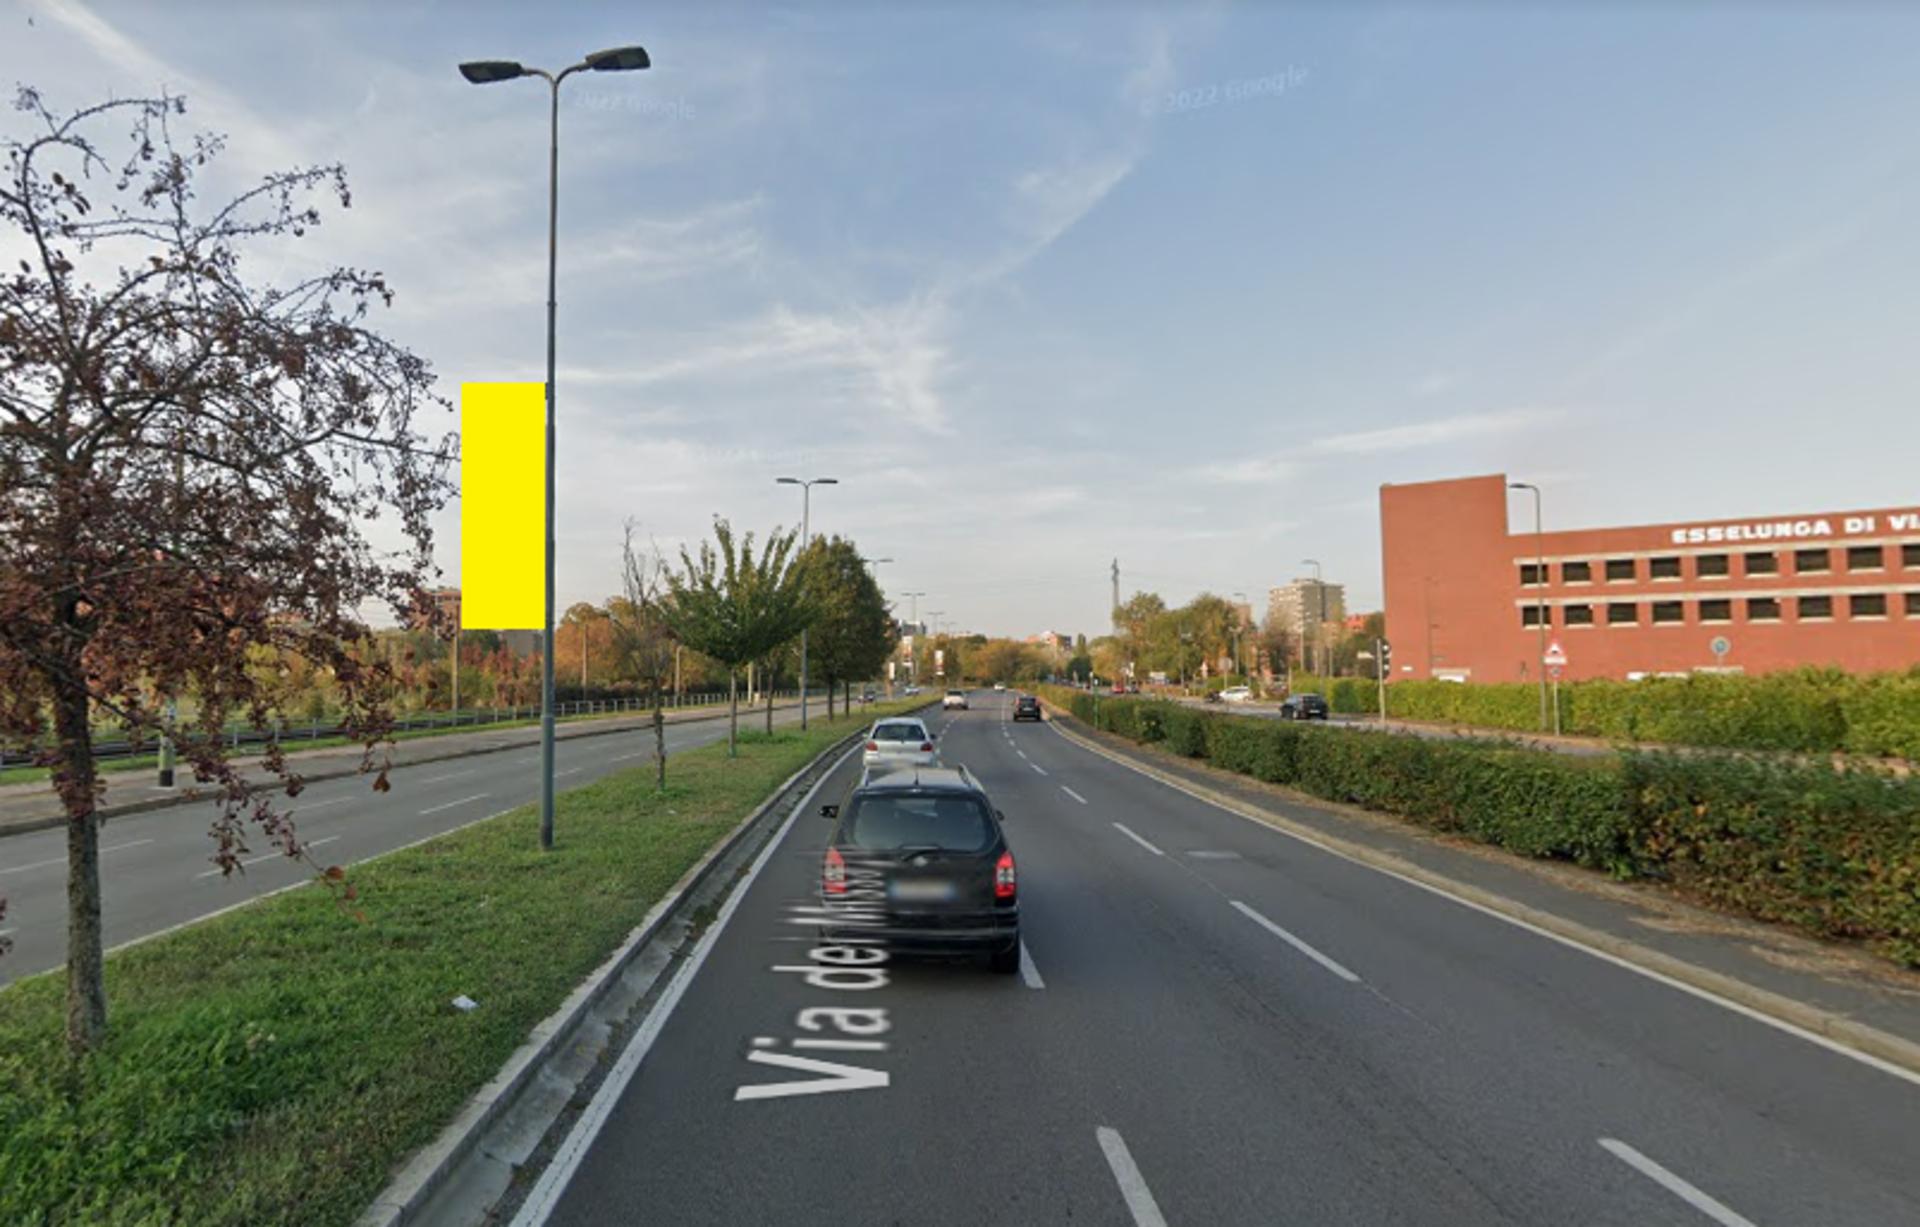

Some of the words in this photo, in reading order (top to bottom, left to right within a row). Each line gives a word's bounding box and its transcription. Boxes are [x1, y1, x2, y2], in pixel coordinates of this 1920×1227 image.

[1672, 519, 1832, 544] ESSELUNGA
[1844, 517, 1875, 534] DI
[1887, 513, 1920, 531] VI
